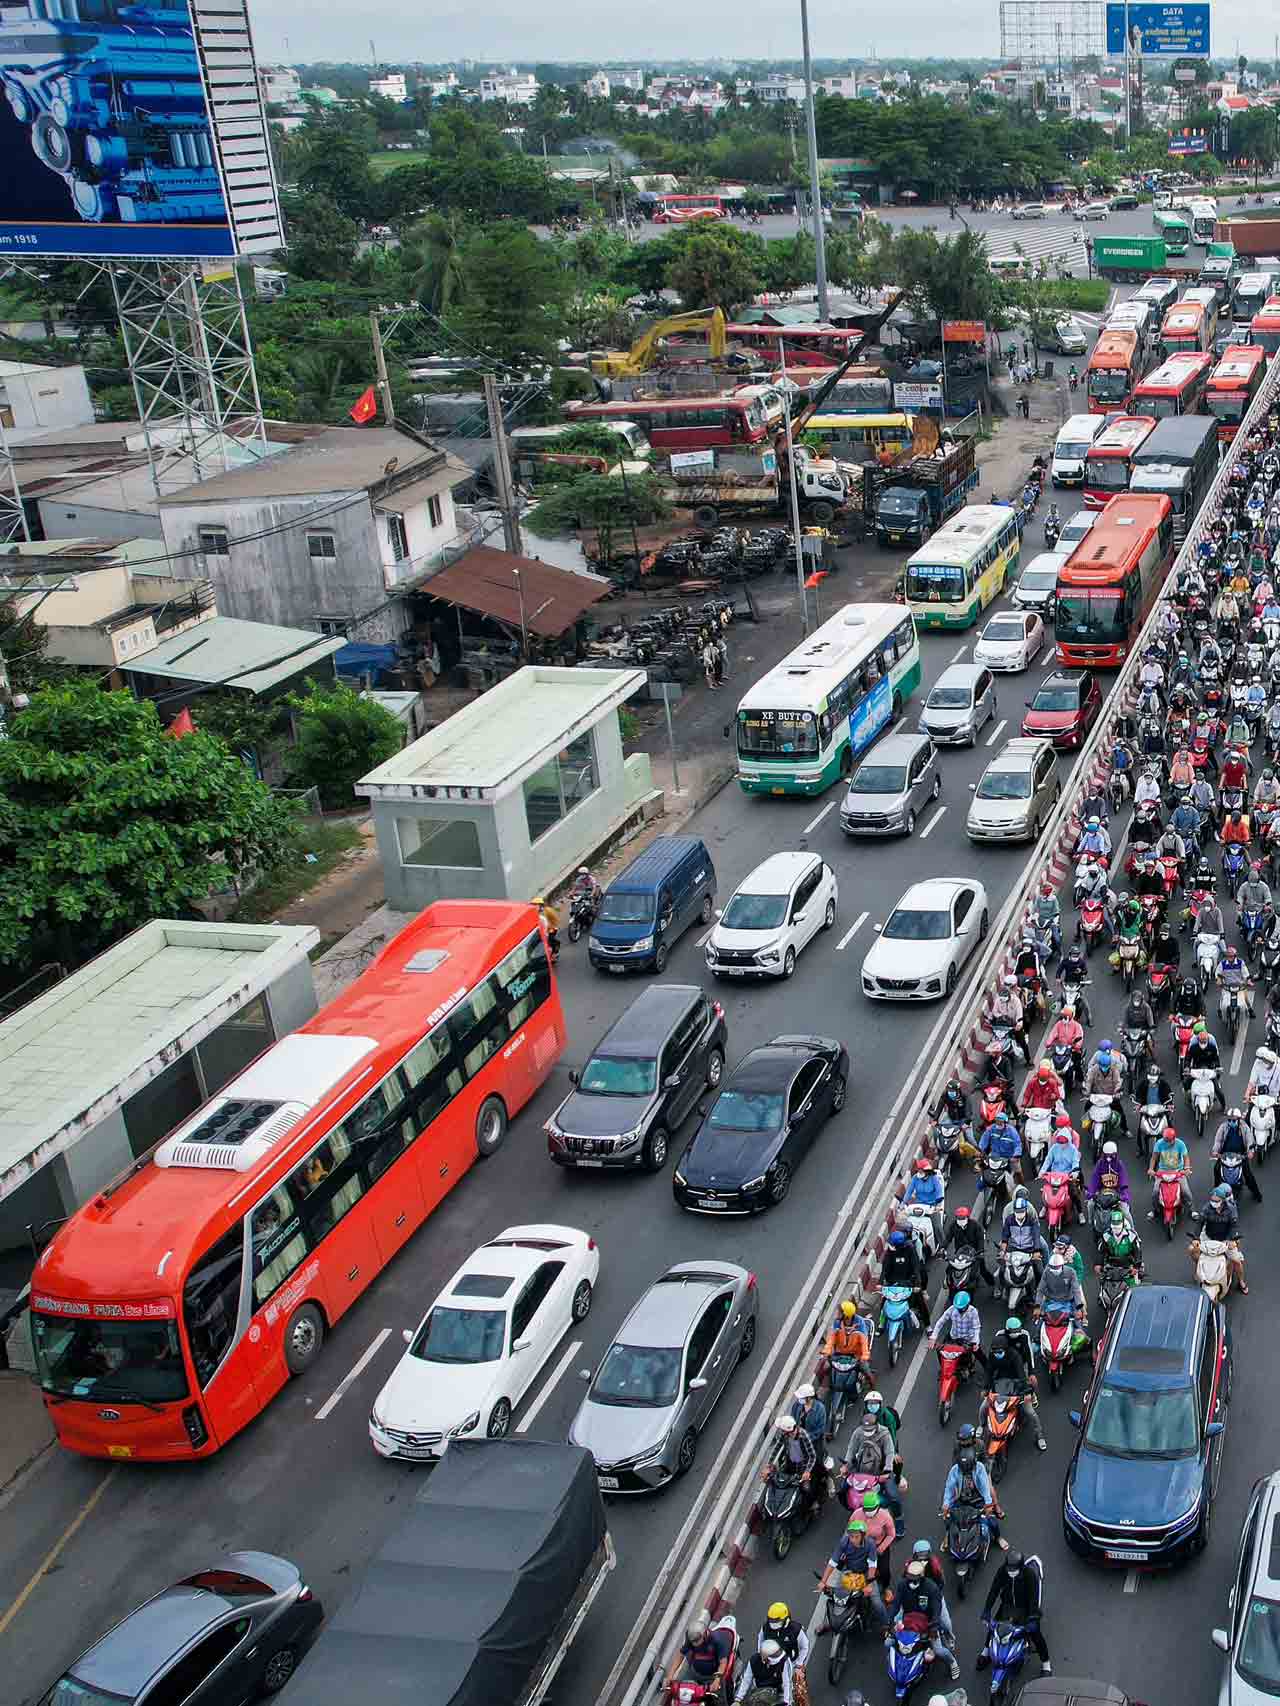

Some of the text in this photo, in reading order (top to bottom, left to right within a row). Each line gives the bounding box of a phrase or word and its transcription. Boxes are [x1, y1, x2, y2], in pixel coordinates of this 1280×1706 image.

[1162, 7, 1184, 16] DATA
[14, 234, 38, 244] 1918
[1103, 247, 1144, 256] EVERGREEN
[762, 711, 775, 720] XE
[143, 1304, 169, 1316] Lines
